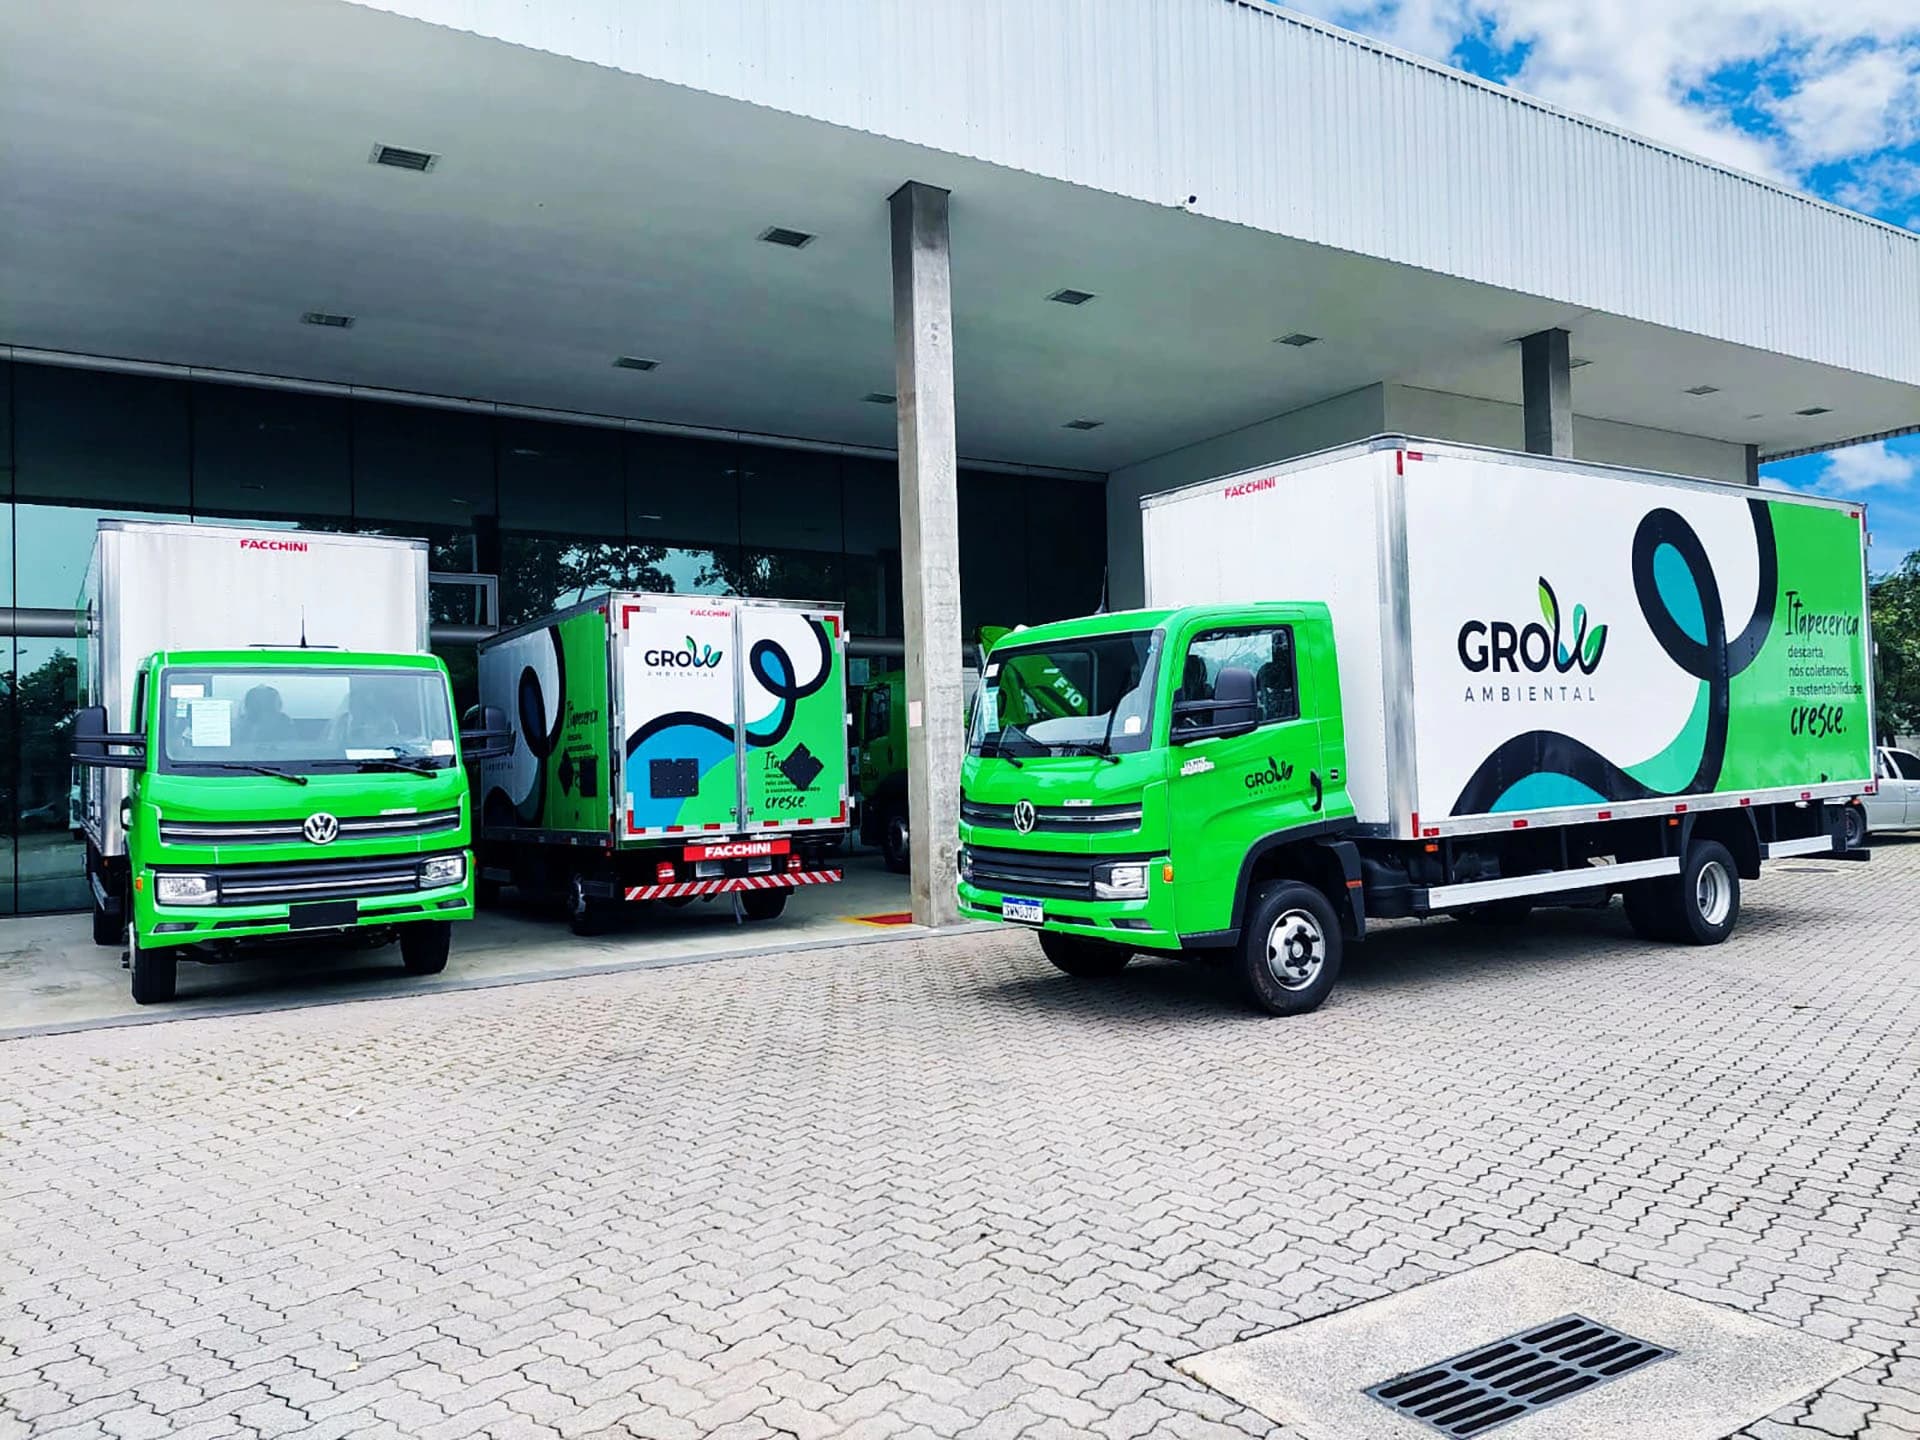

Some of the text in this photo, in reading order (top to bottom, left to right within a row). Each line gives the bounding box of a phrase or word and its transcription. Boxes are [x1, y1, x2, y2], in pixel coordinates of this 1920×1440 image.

[1225, 476, 1276, 499] FACCHINI
[240, 540, 307, 552] FACCHINI
[690, 609, 731, 617] FACCHINI
[1785, 591, 1859, 641] Itapecerica
[1457, 576, 1608, 675] GROW
[644, 635, 723, 668] GROW
[1789, 665, 1804, 677] nós
[1053, 676, 1083, 707] F10
[1464, 686, 1595, 702] AMBIENTAL
[1789, 682, 1863, 696] a sustentabilidade
[1790, 703, 1847, 738] cresce.
[1245, 756, 1294, 788] GROW
[705, 842, 771, 858] FACCHINI
